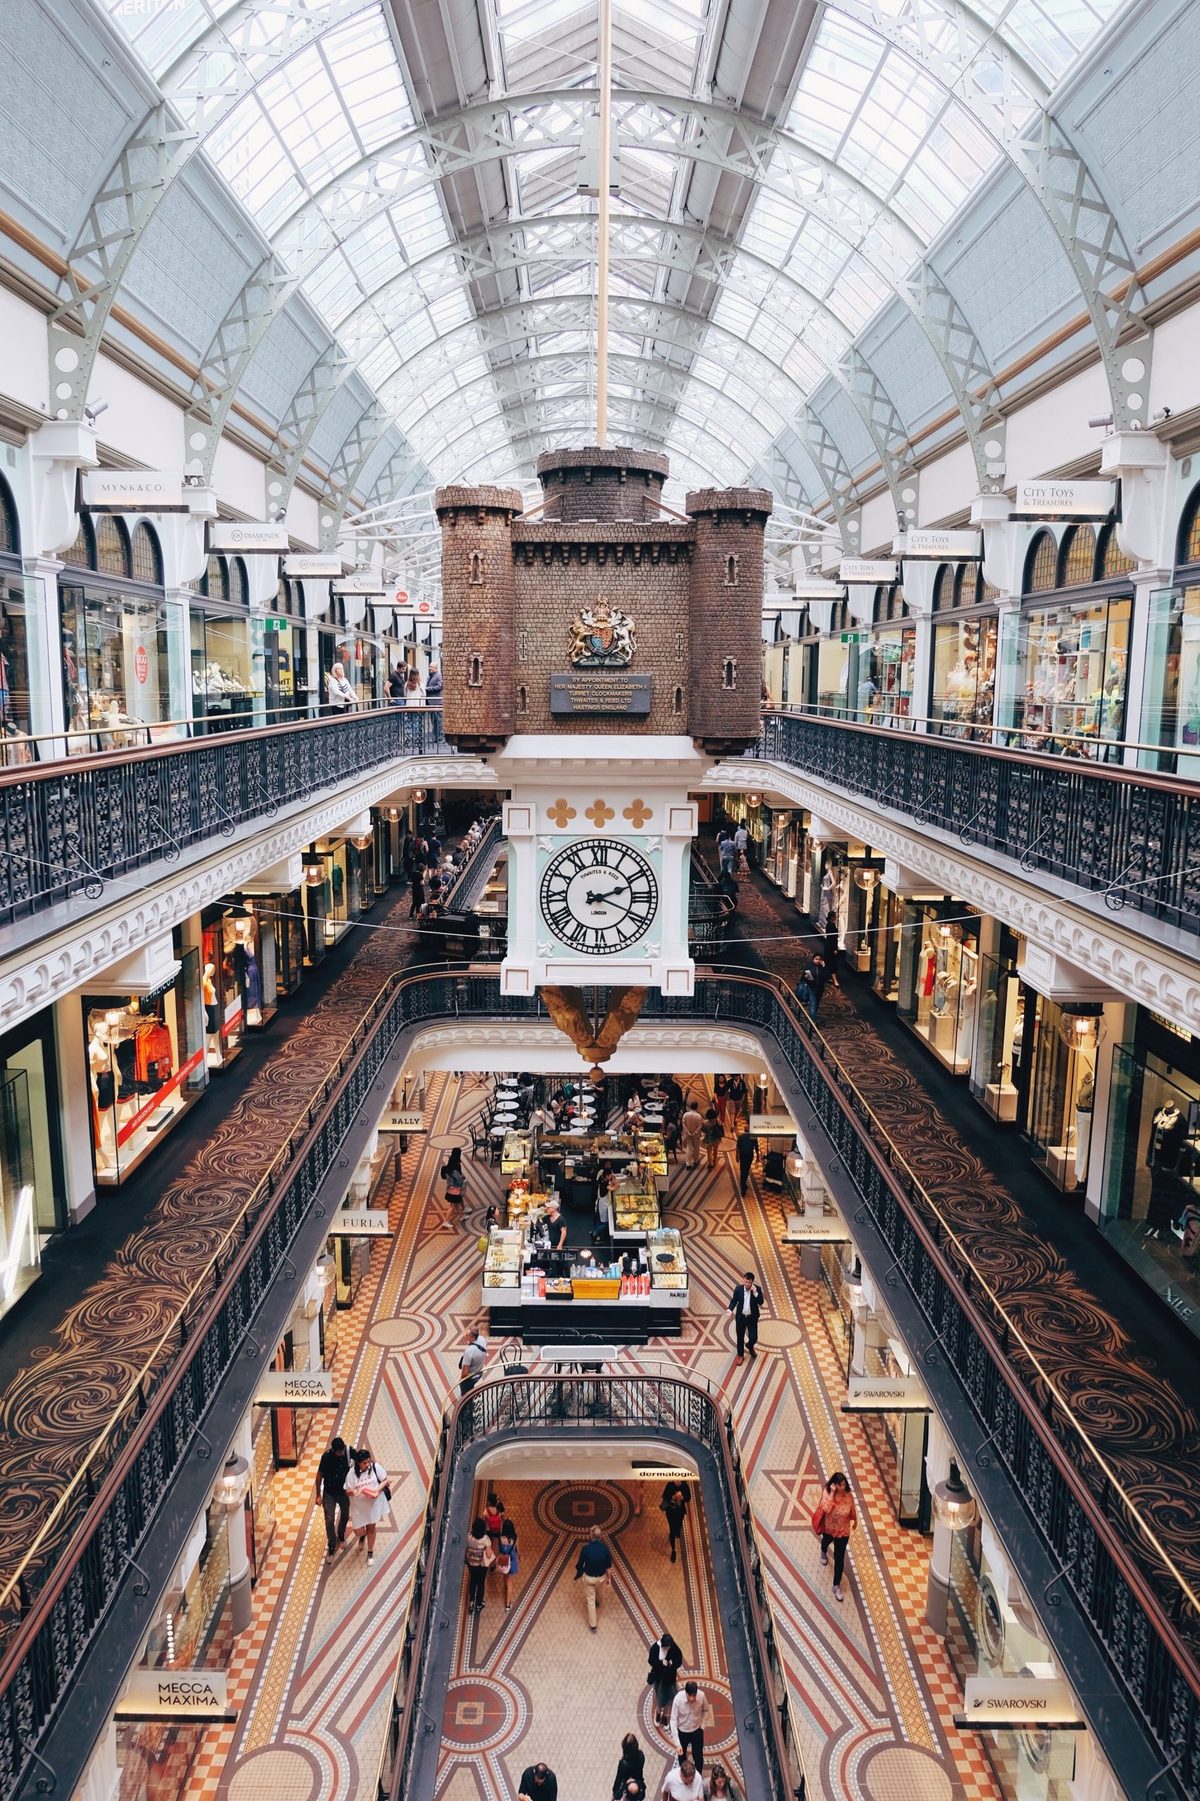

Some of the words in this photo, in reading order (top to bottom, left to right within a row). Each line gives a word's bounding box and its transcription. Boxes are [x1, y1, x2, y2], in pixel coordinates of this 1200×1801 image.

[1032, 498, 1073, 506] TREASURES
[343, 1218, 385, 1228] FURLA
[284, 1380, 323, 1389] MECCA
[284, 1389, 328, 1397] MAXIMA
[863, 1390, 905, 1398] SWAROVSKI
[158, 1682, 213, 1694] MECCA
[158, 1695, 219, 1706] MAXIMA
[986, 1699, 1047, 1709] SWAROVSKI
